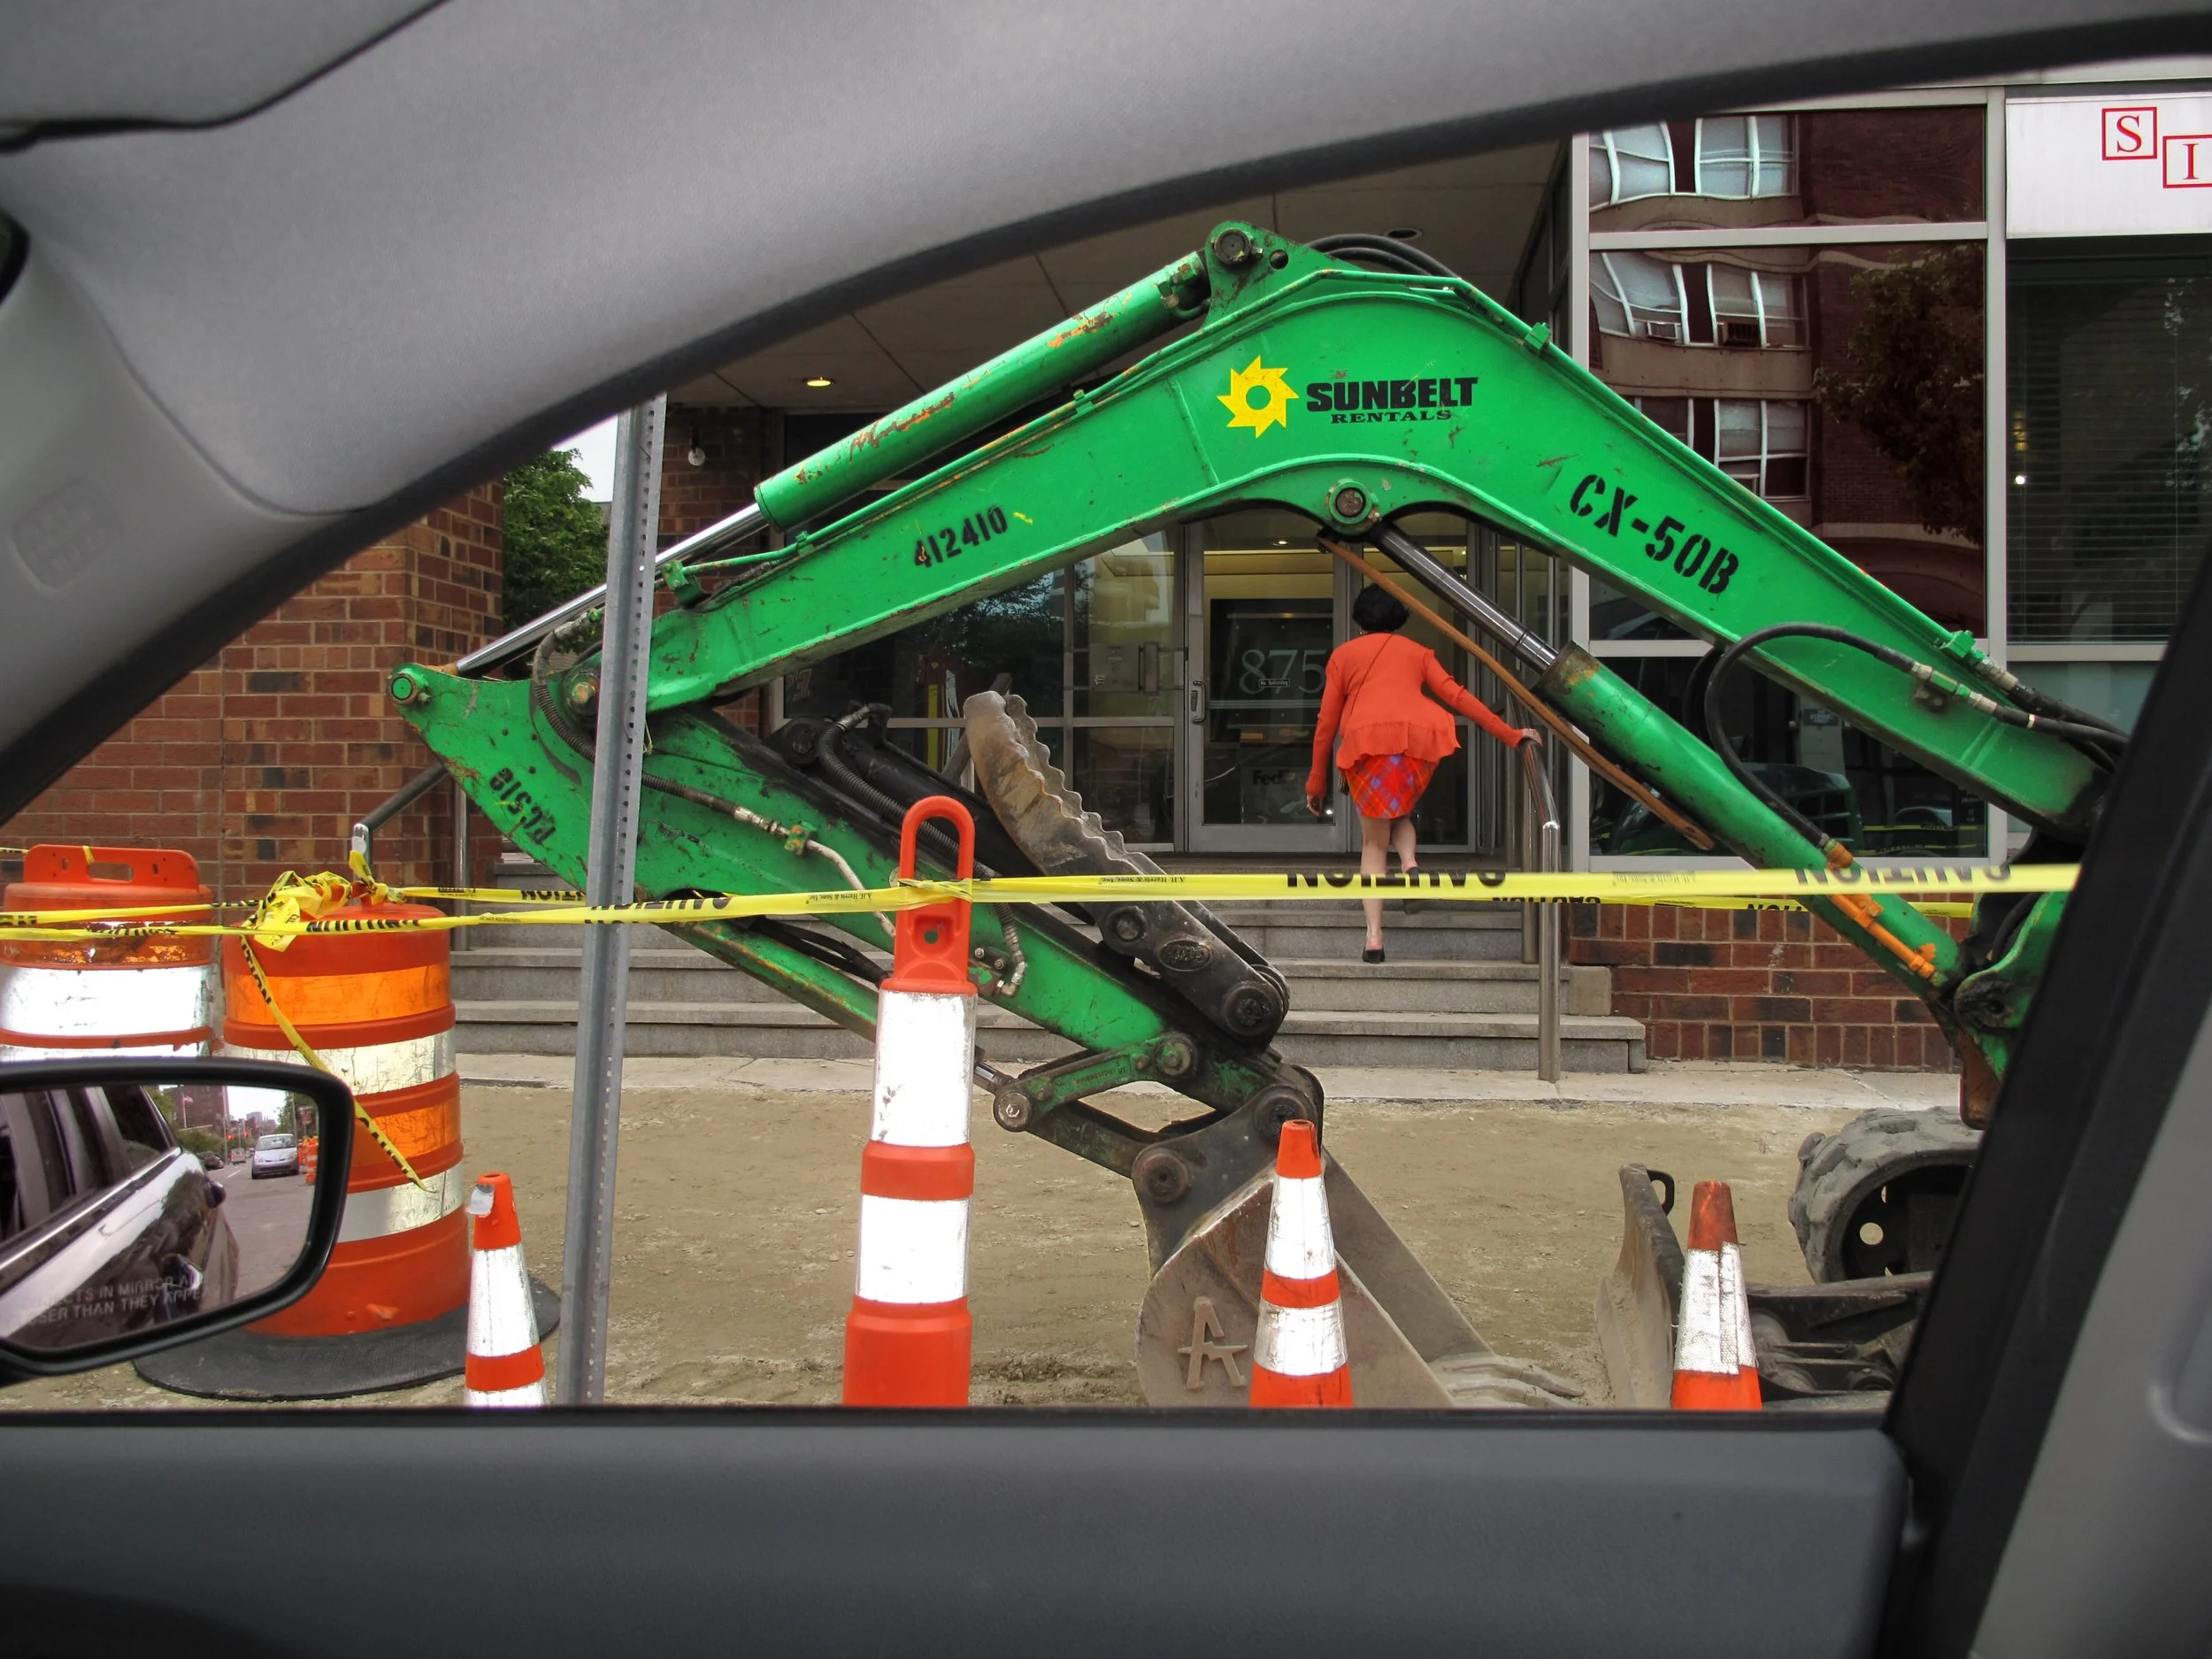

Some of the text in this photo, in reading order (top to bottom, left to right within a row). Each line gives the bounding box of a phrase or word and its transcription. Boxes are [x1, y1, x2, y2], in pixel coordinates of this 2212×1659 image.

[1306, 377, 1479, 412] SUNBELT
[1331, 410, 1452, 424] RENTALS
[915, 505, 1008, 567] 412410
[1570, 474, 1739, 594] CX-50B
[1239, 649, 1326, 695] 875
[72, 1302, 114, 1318] THAN
[120, 1294, 159, 1312] THEY
[98, 1284, 113, 1299] IN
